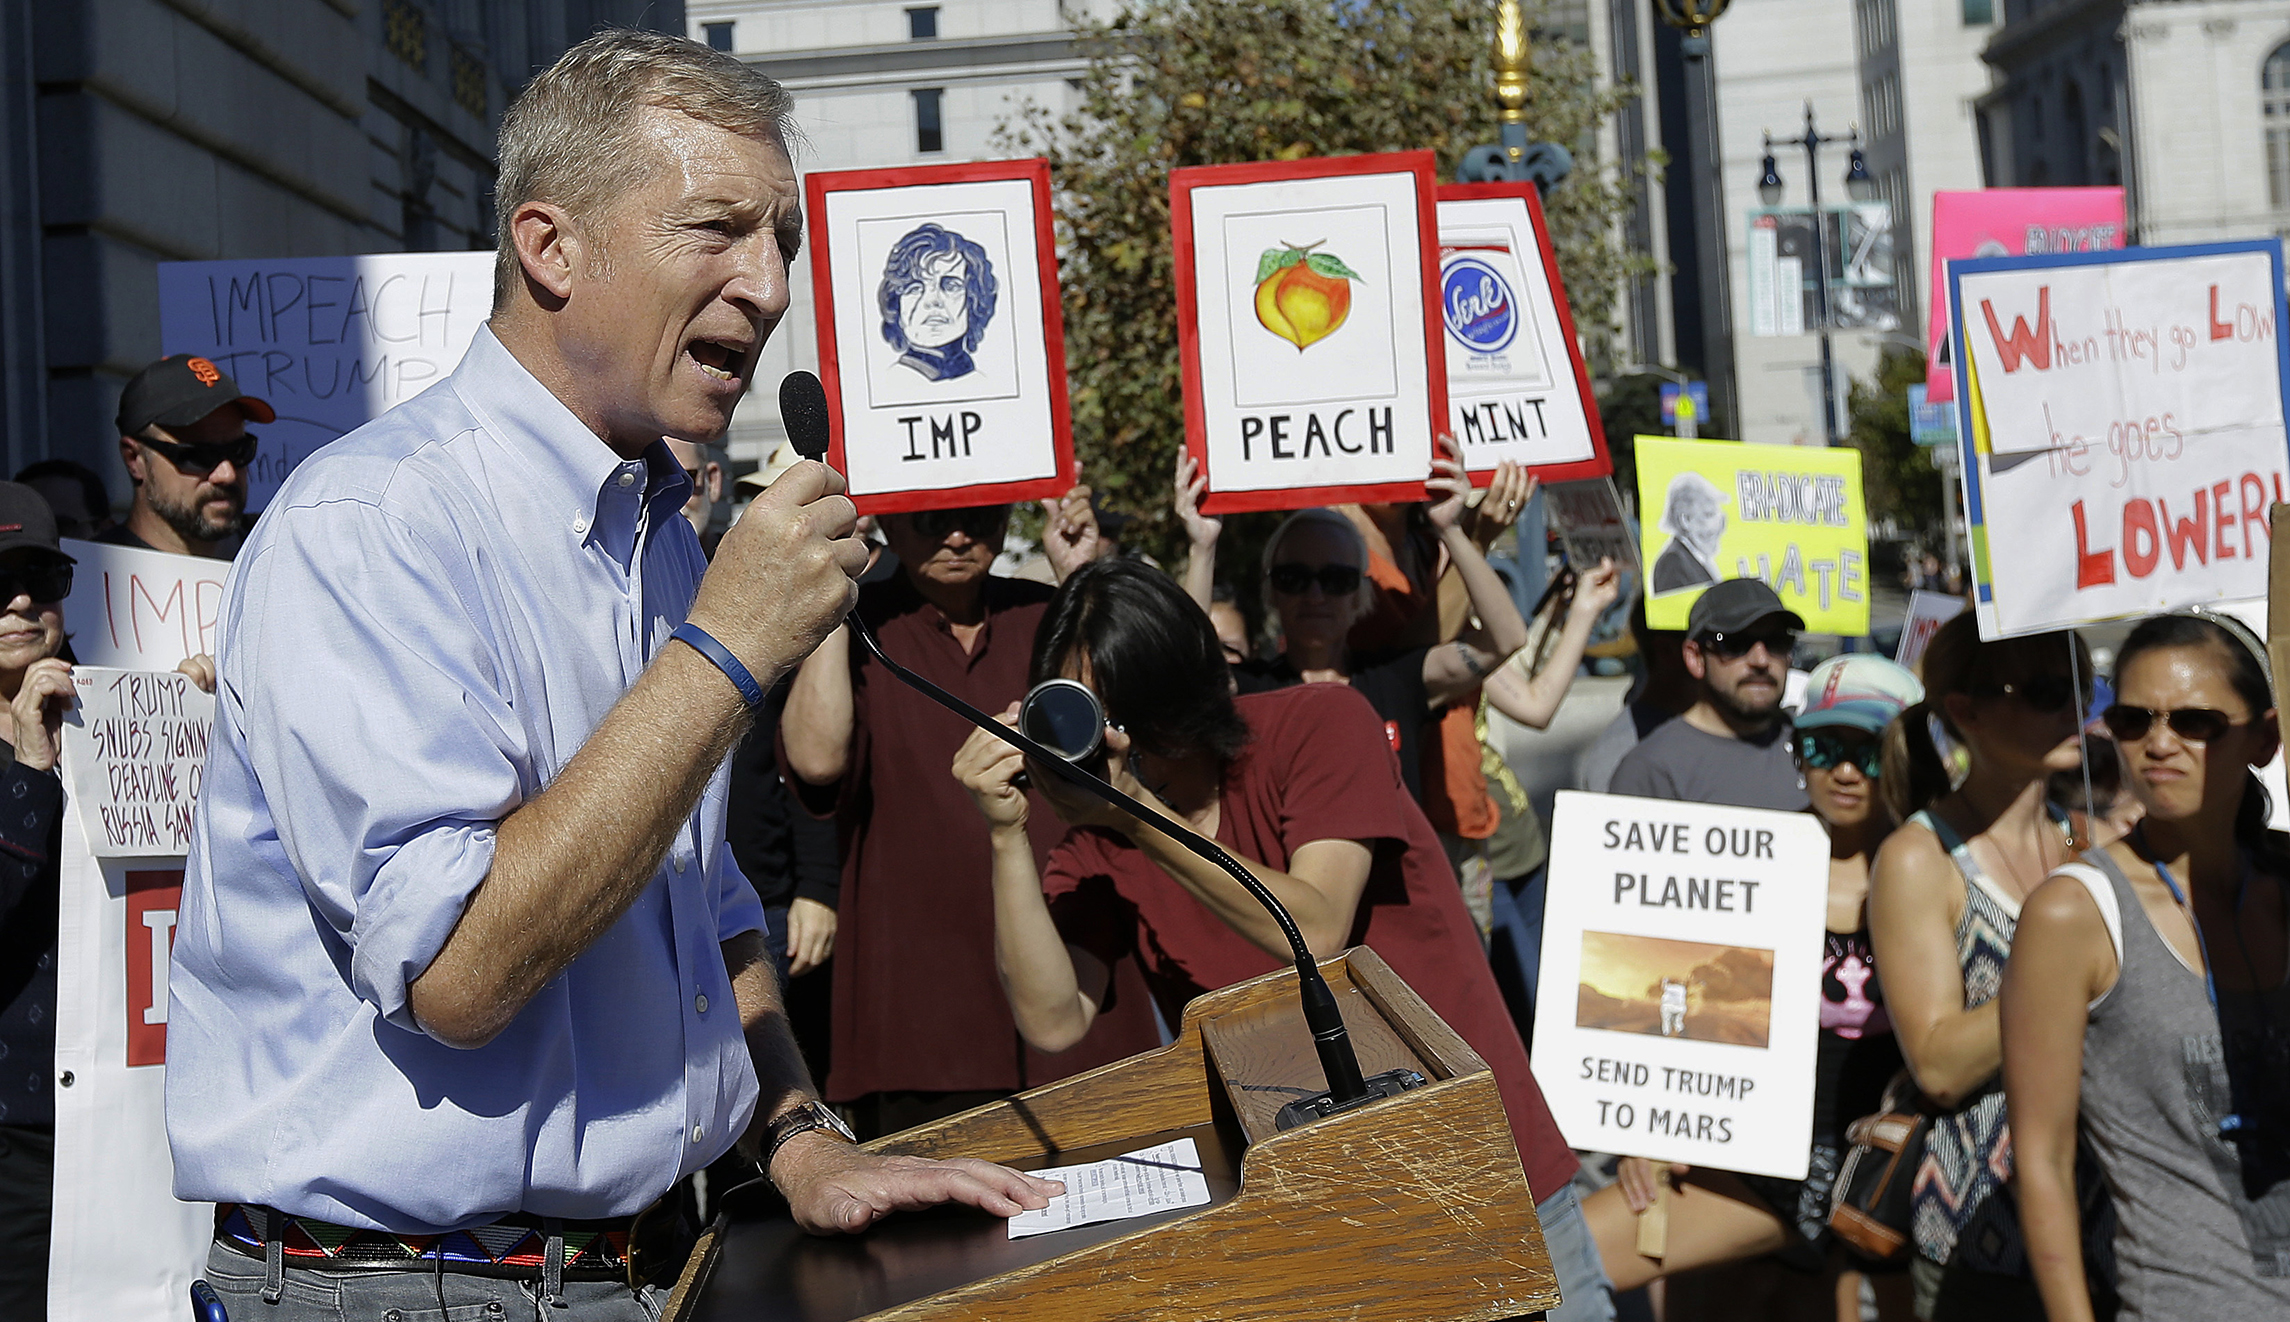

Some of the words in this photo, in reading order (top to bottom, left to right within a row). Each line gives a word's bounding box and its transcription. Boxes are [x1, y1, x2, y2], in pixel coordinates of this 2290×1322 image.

[208, 271, 455, 347] IMPEACH
[1981, 285, 2100, 373] When
[2102, 307, 2158, 375] they
[2169, 325, 2197, 373] go
[209, 350, 438, 402] TRUMP
[898, 412, 982, 461] IMP
[1241, 406, 1395, 460] PEACH
[1459, 398, 1547, 444] MINT
[2042, 400, 2091, 479] he
[2107, 412, 2183, 489] goes
[1737, 470, 1848, 526] ERADICATE
[1737, 543, 1863, 610] HATE
[104, 571, 224, 660] IMP
[109, 673, 186, 718] TRUMP
[92, 717, 151, 762] SNUBS
[107, 760, 179, 804] DEADLINE
[189, 763, 204, 801] O
[100, 803, 160, 847] RUSSIA
[165, 800, 196, 850] SAN
[1604, 820, 1689, 853] SAVE
[1705, 827, 1774, 859] OUR
[1614, 872, 1760, 914] PLANET
[1580, 1056, 1649, 1087] SEND
[1662, 1066, 1754, 1101] TRUMP
[1597, 1100, 1634, 1129] TO
[1649, 1107, 1732, 1144] MARS
